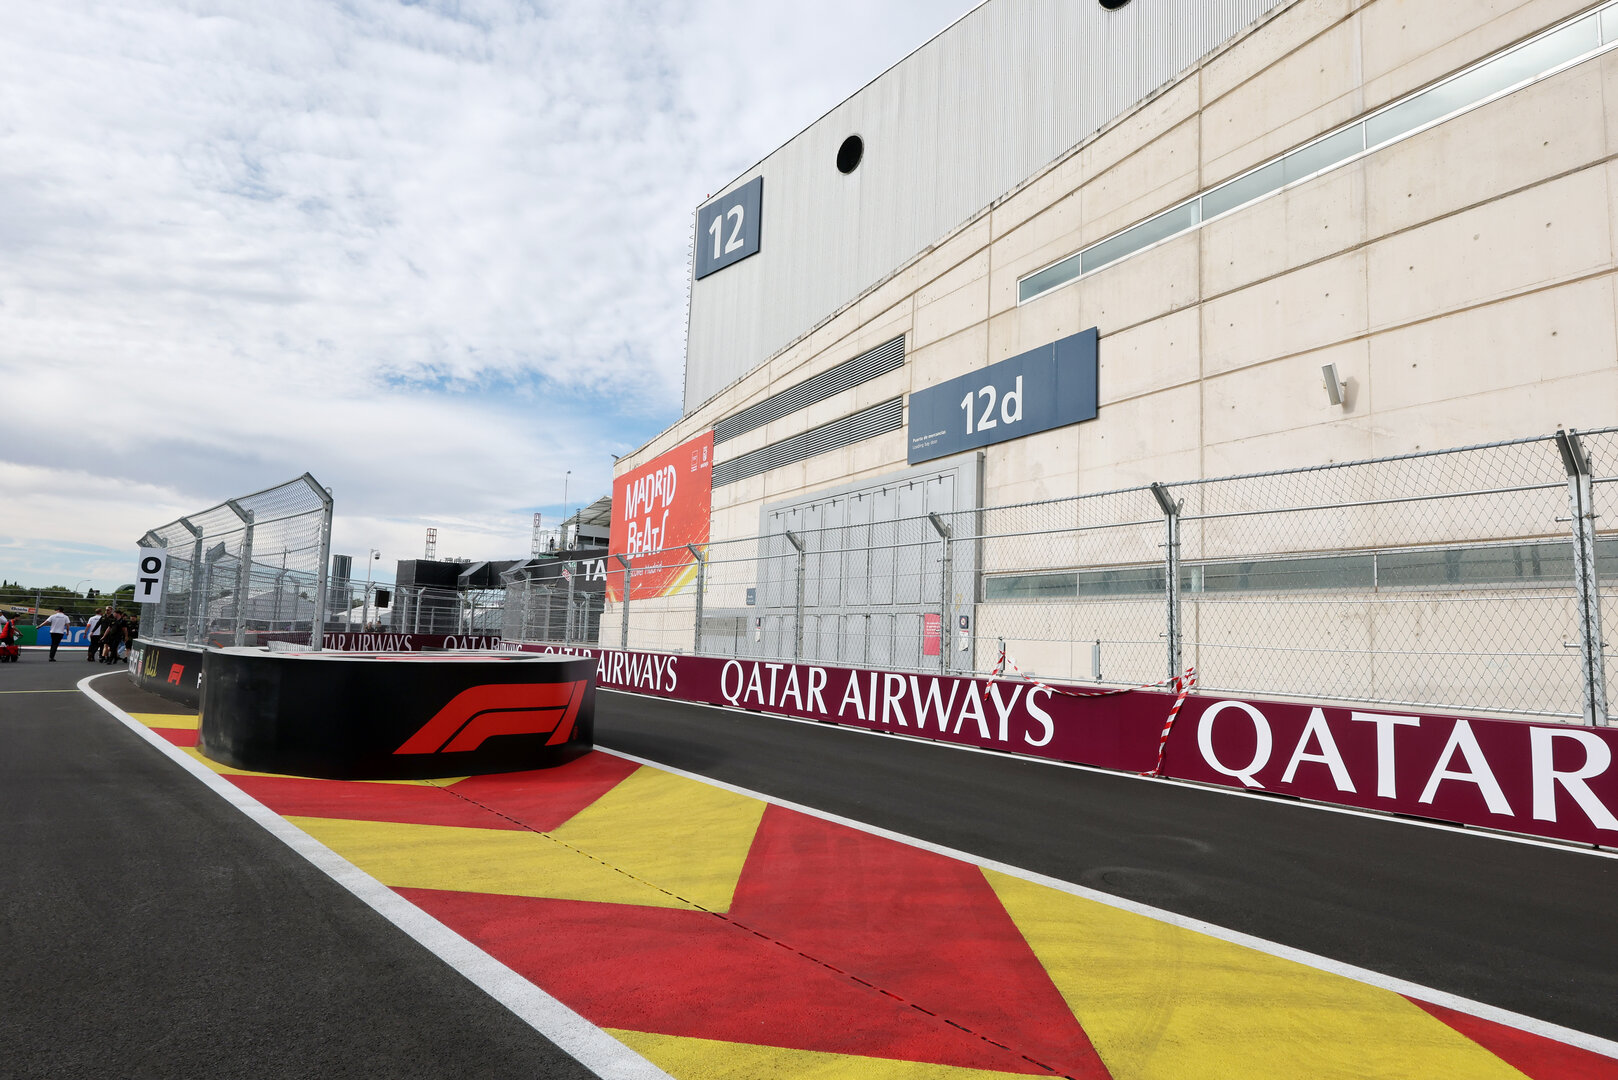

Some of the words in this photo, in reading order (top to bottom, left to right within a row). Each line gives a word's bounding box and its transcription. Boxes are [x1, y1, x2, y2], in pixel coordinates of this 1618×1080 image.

[709, 204, 744, 260] 12
[960, 375, 1023, 435] 12d
[349, 634, 412, 651] AIRWAYS
[596, 650, 678, 693] AIRWAYS
[720, 659, 828, 715] QATAR
[838, 670, 1055, 747] AIRWAYS
[1197, 700, 1618, 831] QATAR
